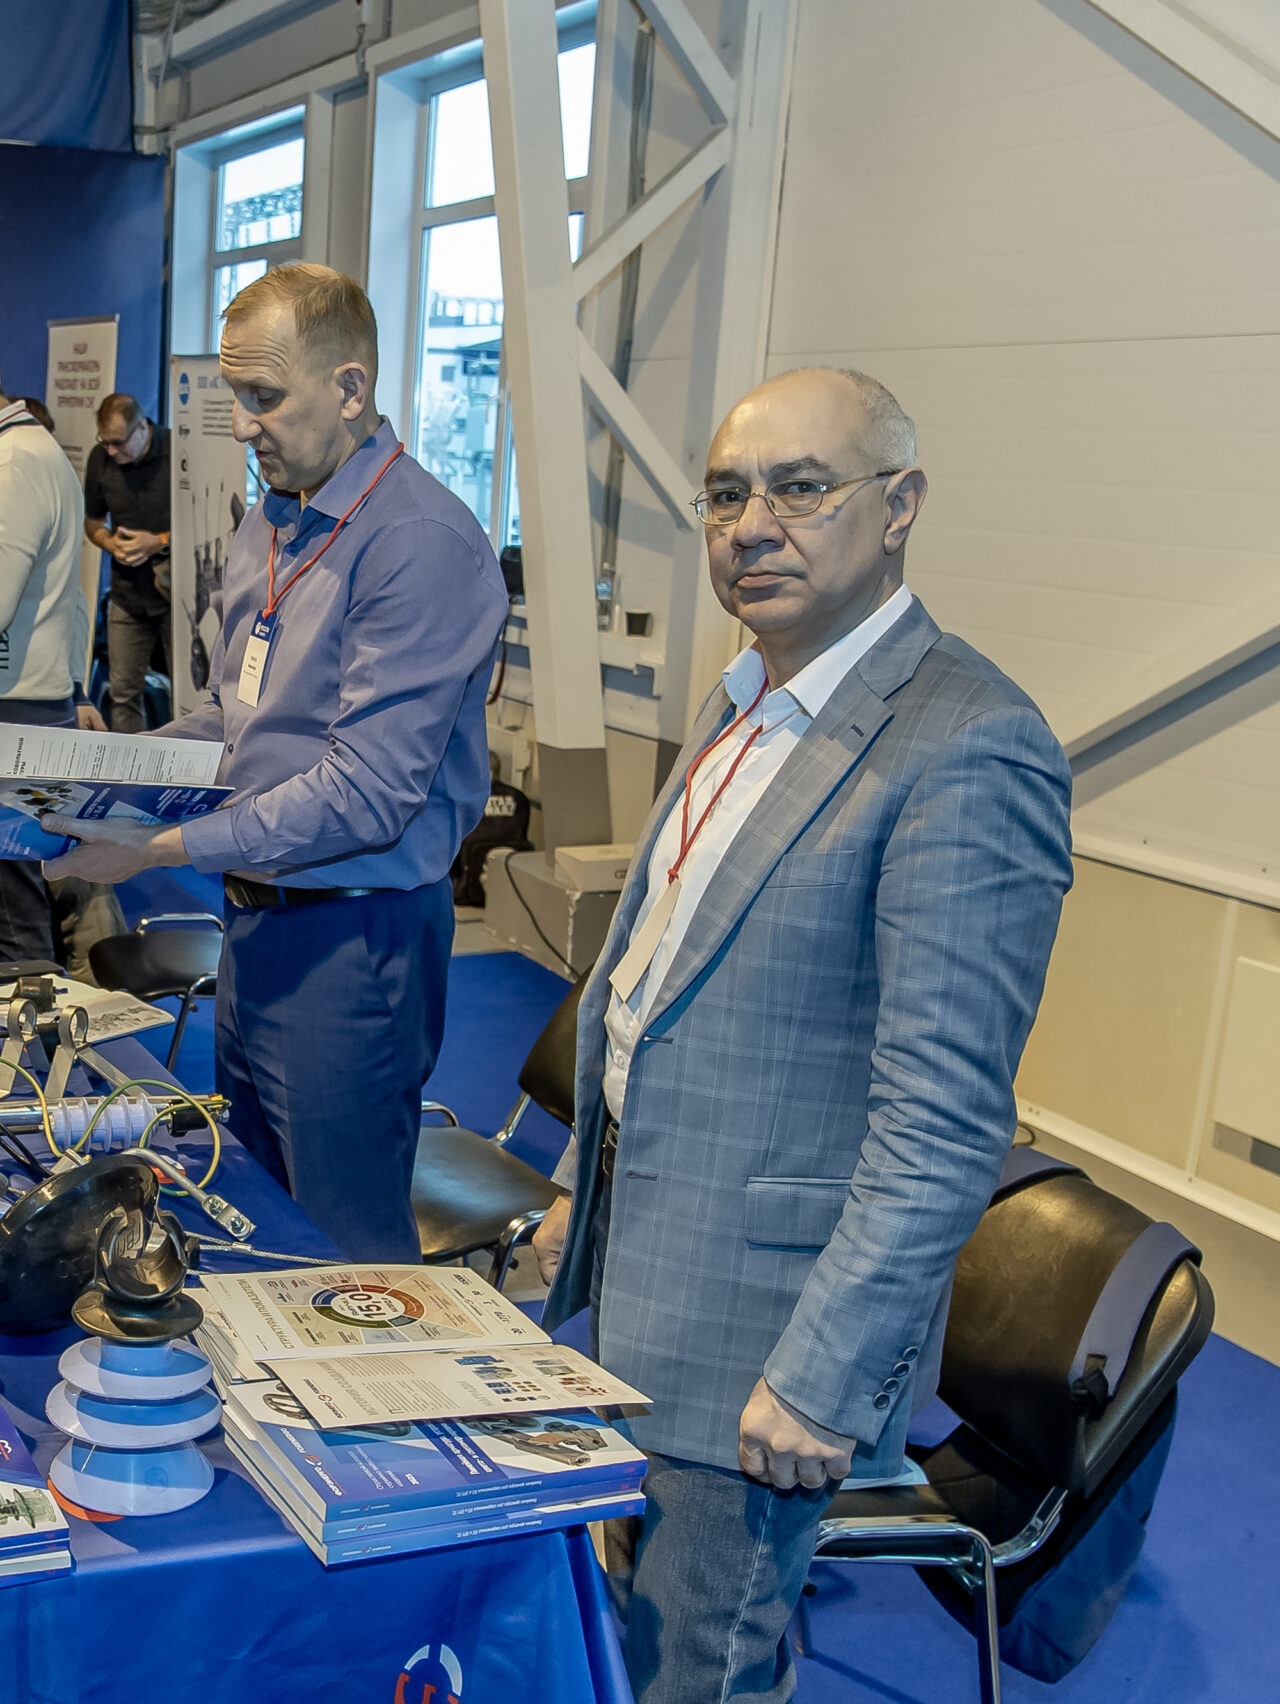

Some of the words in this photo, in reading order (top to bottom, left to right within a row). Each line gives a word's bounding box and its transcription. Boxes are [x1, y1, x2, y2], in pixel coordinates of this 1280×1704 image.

[237, 1279, 268, 1312] ПОКАЗАТЕЛИ
[349, 1293, 386, 1318] 15,0
[265, 1317, 294, 1349] СТРУКТУРА
